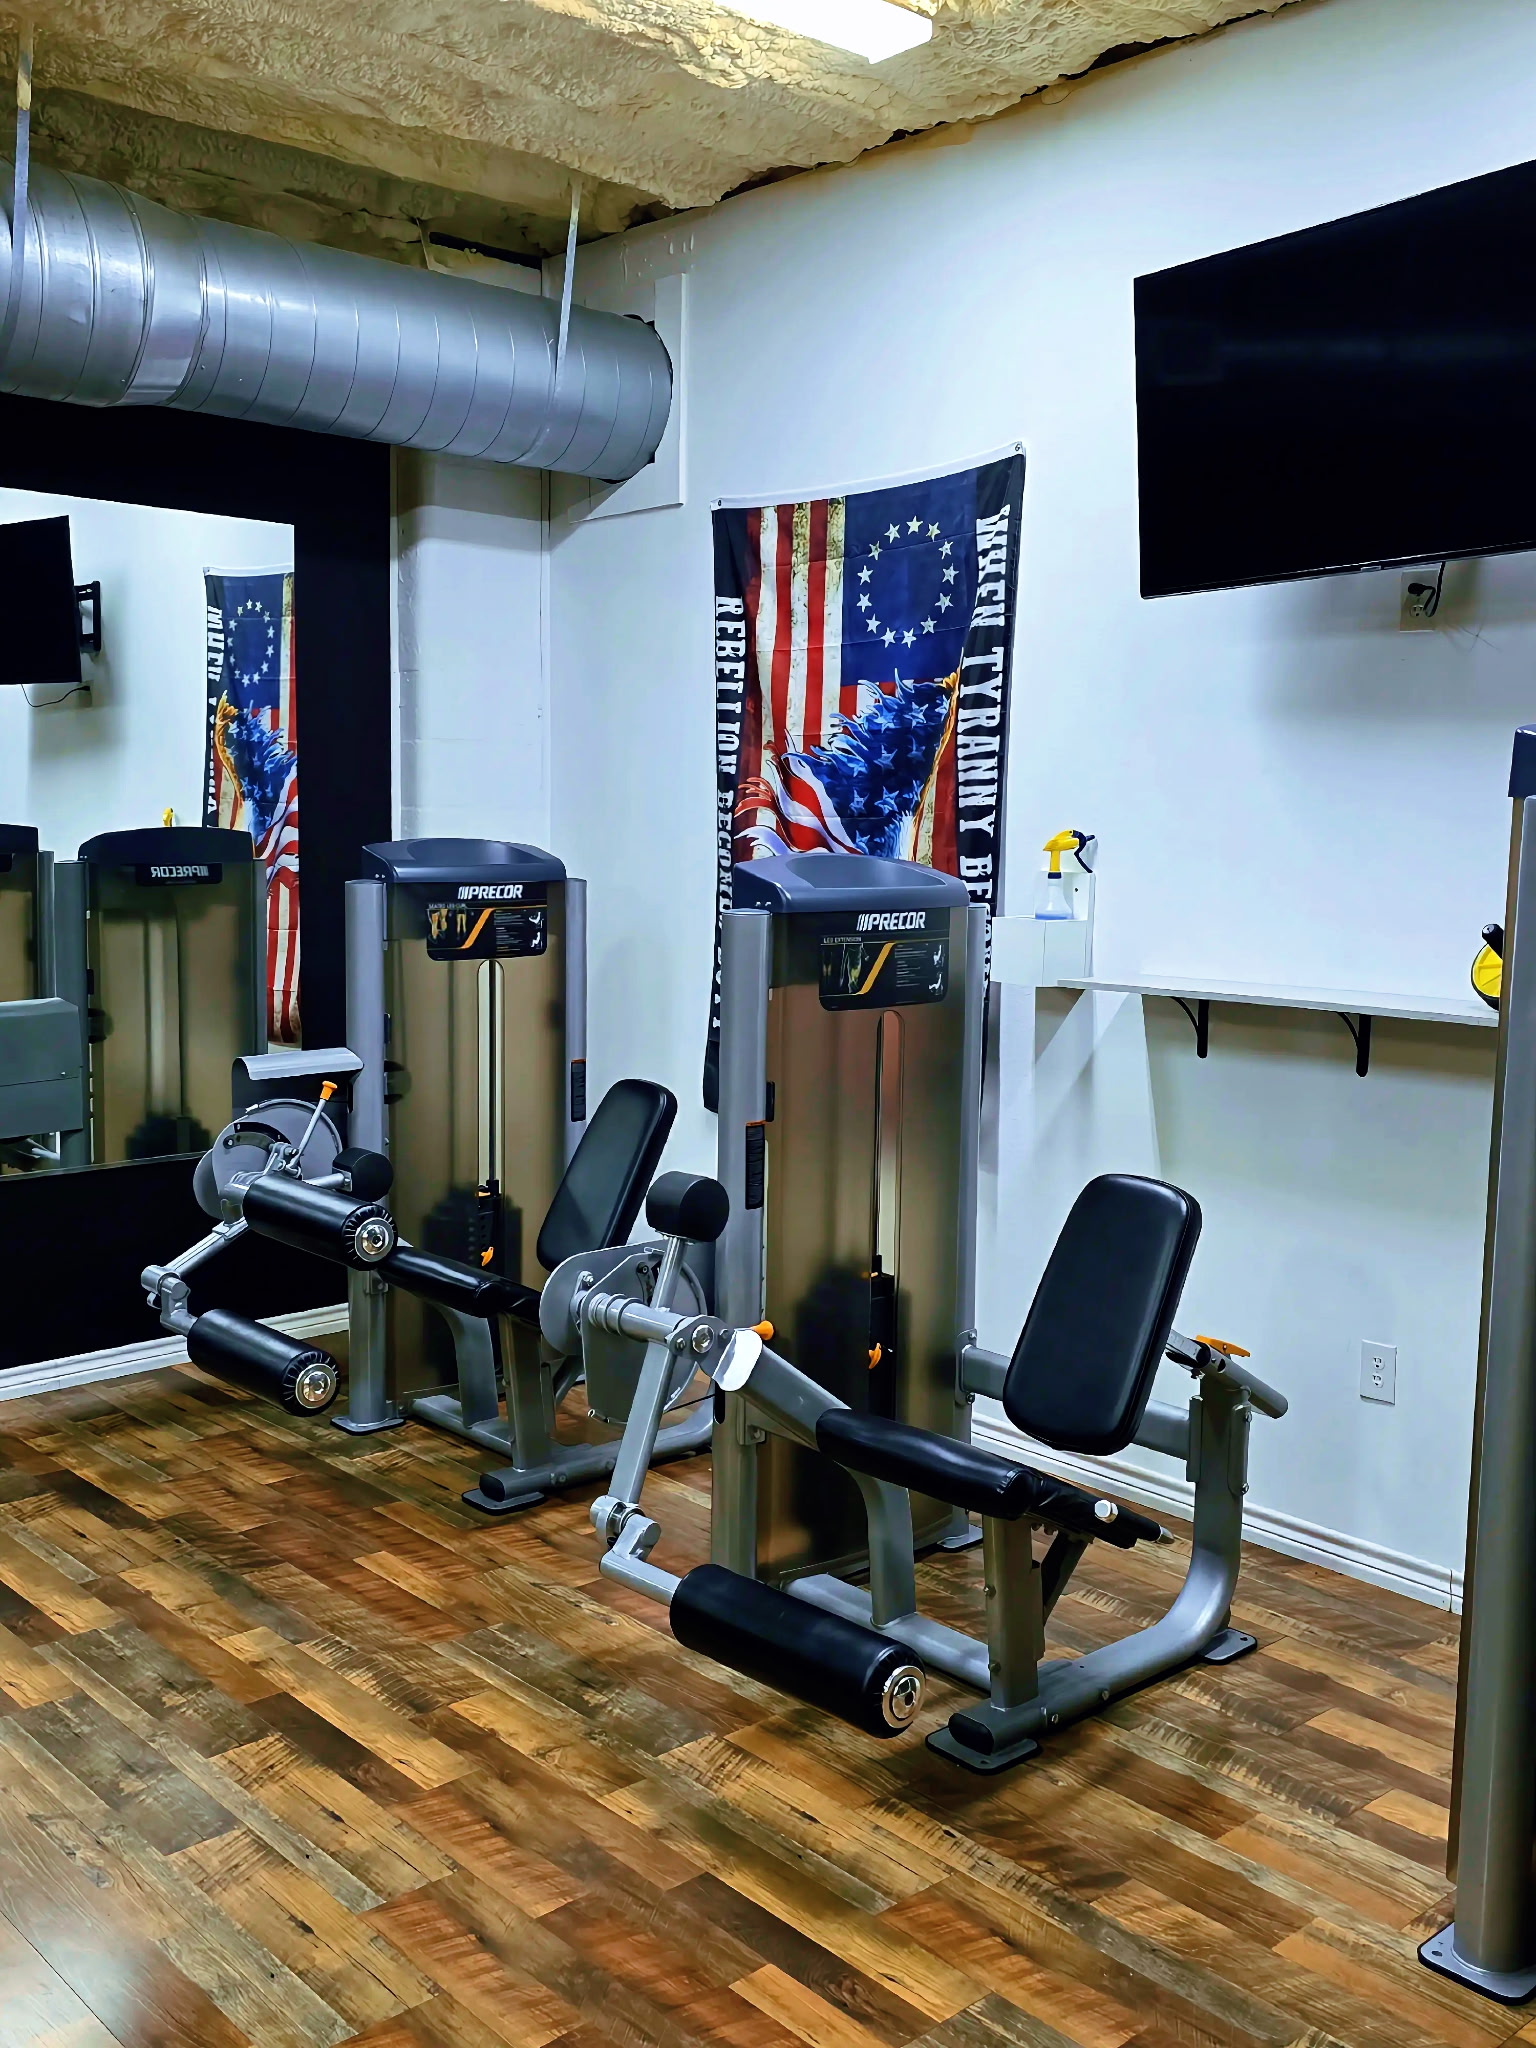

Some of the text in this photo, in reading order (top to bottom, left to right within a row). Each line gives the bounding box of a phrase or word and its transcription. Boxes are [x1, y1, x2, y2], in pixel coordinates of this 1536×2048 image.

[970, 504, 1010, 630] WHEN
[715, 596, 746, 774] REBELLION
[957, 646, 1005, 838] TYRANNY
[468, 884, 523, 899] PRECOR
[868, 911, 926, 930] PRECOR
